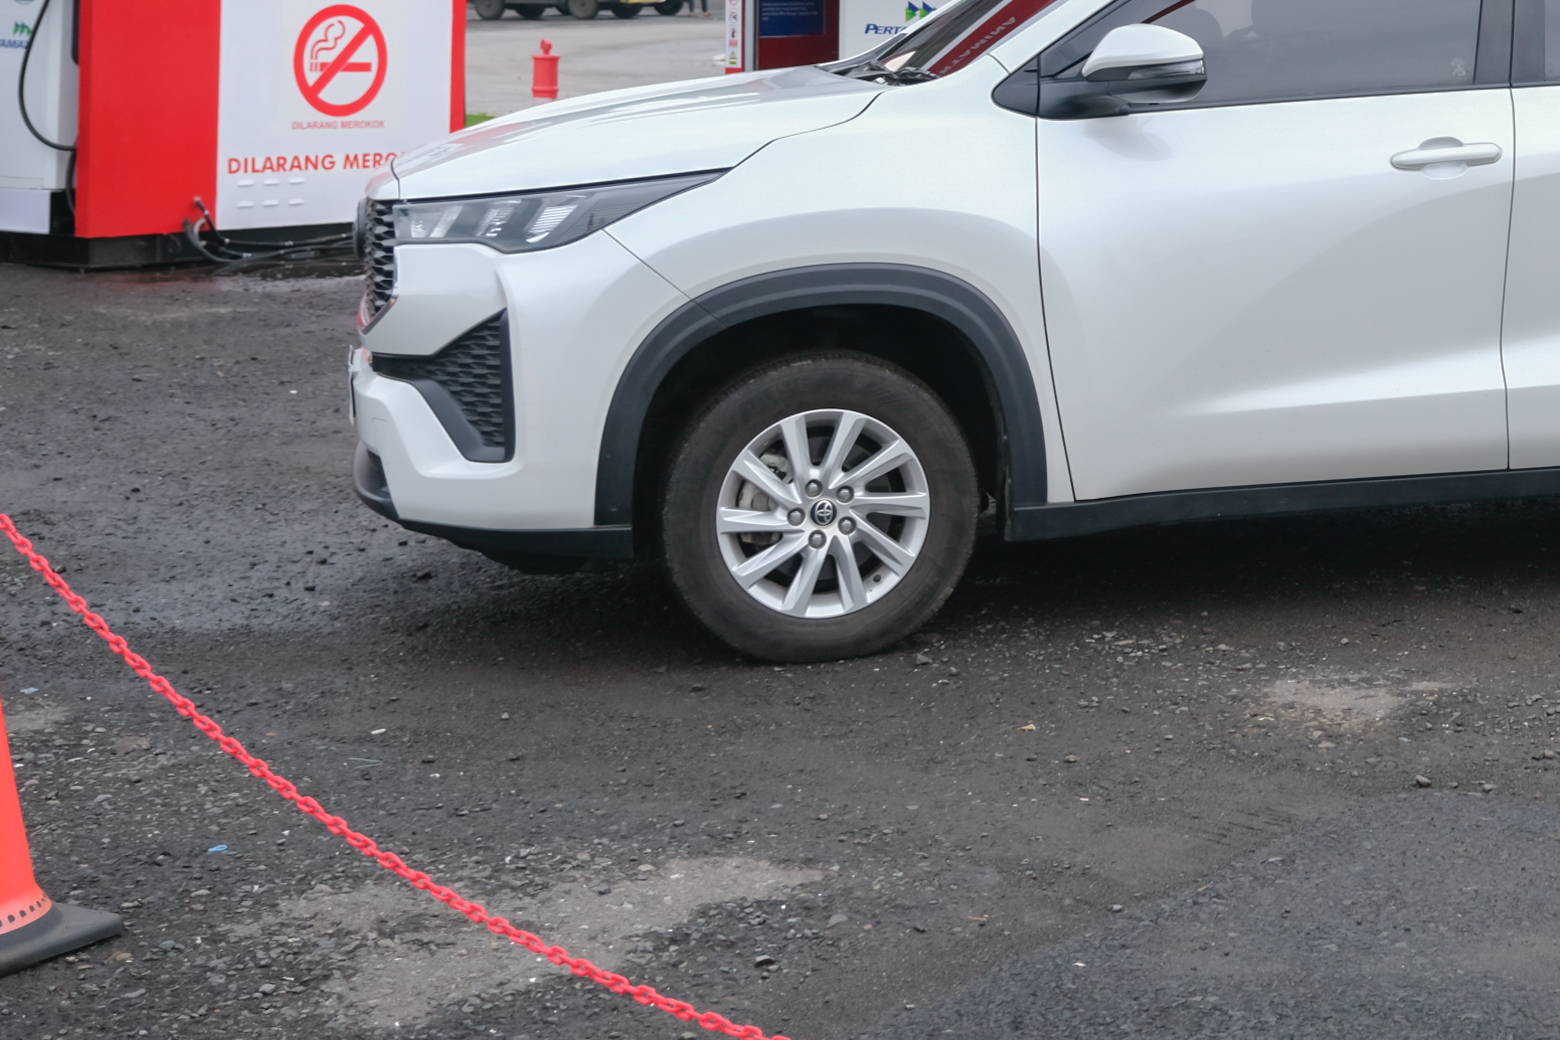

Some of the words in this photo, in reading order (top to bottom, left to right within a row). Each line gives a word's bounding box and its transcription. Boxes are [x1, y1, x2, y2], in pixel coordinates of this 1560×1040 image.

[865, 23, 908, 35] PERT
[291, 121, 338, 130] DILARANG
[341, 120, 385, 129] MEROKOK
[228, 154, 336, 174] DILARANG
[343, 152, 404, 170] MERO
